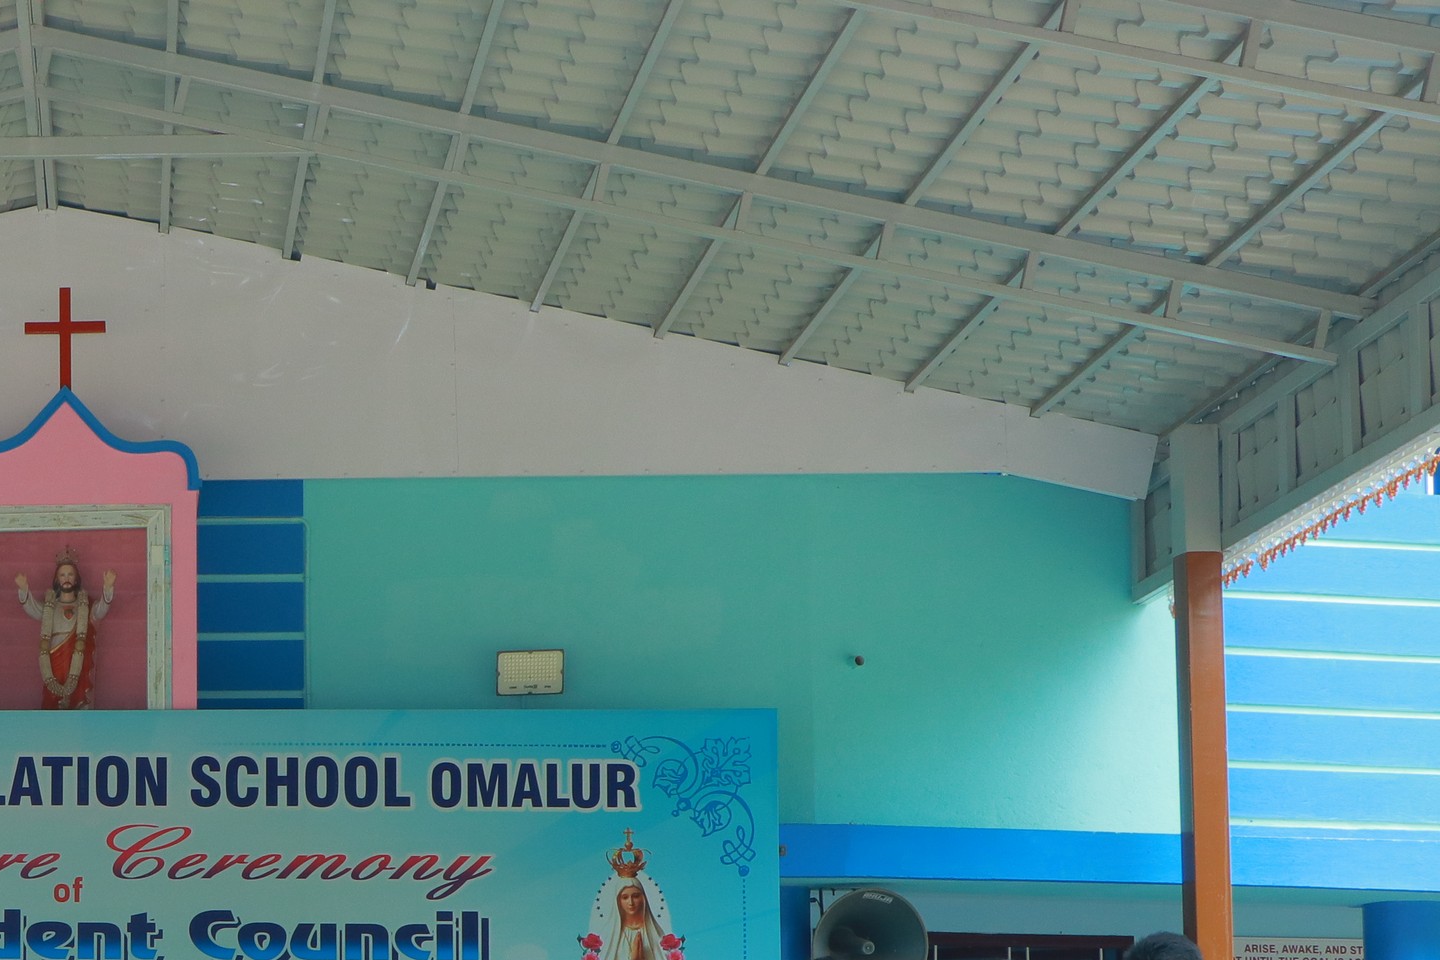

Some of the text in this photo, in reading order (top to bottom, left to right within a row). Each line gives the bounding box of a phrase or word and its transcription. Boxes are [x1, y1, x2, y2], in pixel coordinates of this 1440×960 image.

[190, 756, 411, 808] SCHOOL
[431, 762, 637, 809] OMALUR
[106, 824, 493, 901] Ceremony
[53, 877, 84, 903] of
[1244, 944, 1279, 954] ARISE,
[1282, 945, 1322, 955] AWAKE,
[1325, 945, 1347, 954] AND
